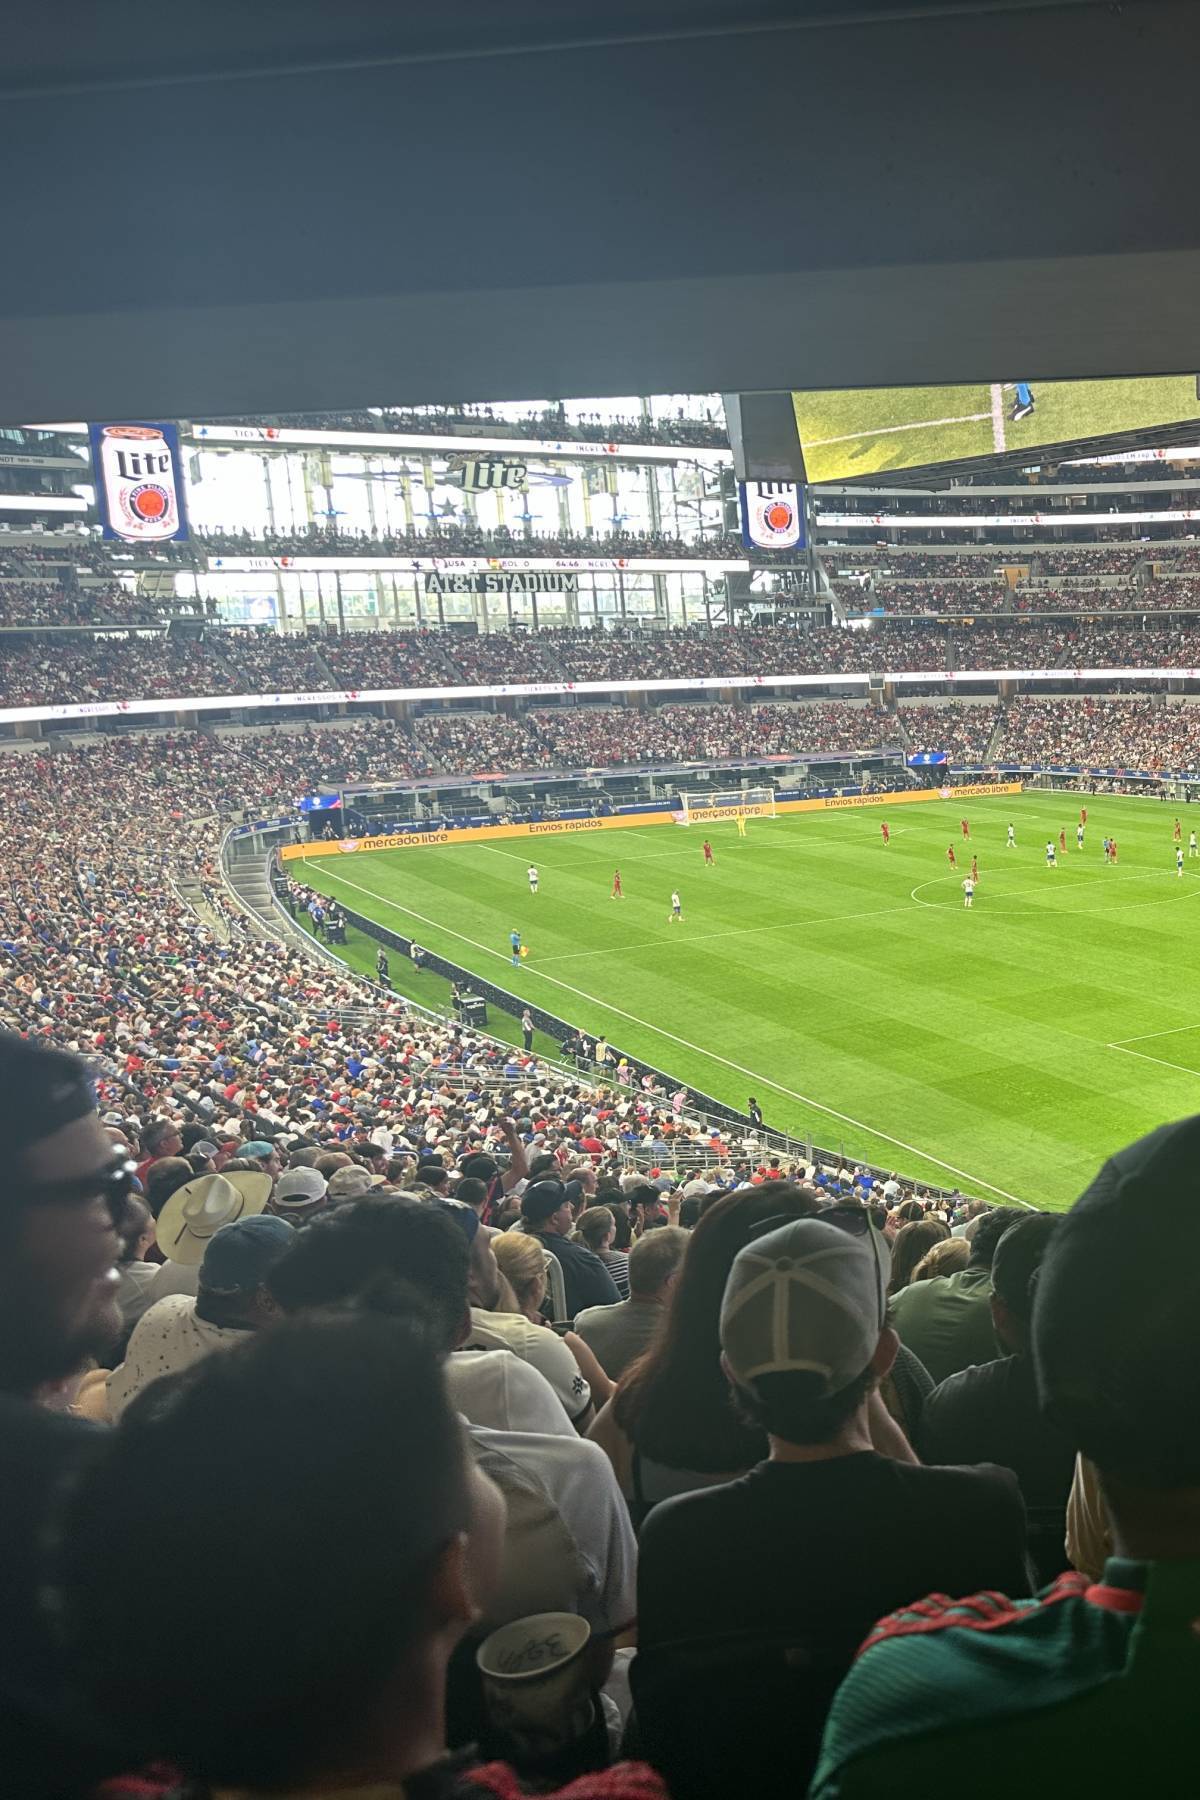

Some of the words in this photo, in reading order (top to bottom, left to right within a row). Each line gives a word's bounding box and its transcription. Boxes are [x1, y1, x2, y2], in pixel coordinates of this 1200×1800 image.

[114, 450, 169, 481] Lite
[460, 460, 527, 494] Lite
[427, 573, 480, 593] AT&T
[485, 573, 579, 593] STADIUM
[954, 786, 990, 796] mercado
[991, 784, 1009, 794] libre
[692, 807, 738, 820] mercado
[364, 835, 420, 848] mercado
[421, 833, 448, 844] libre
